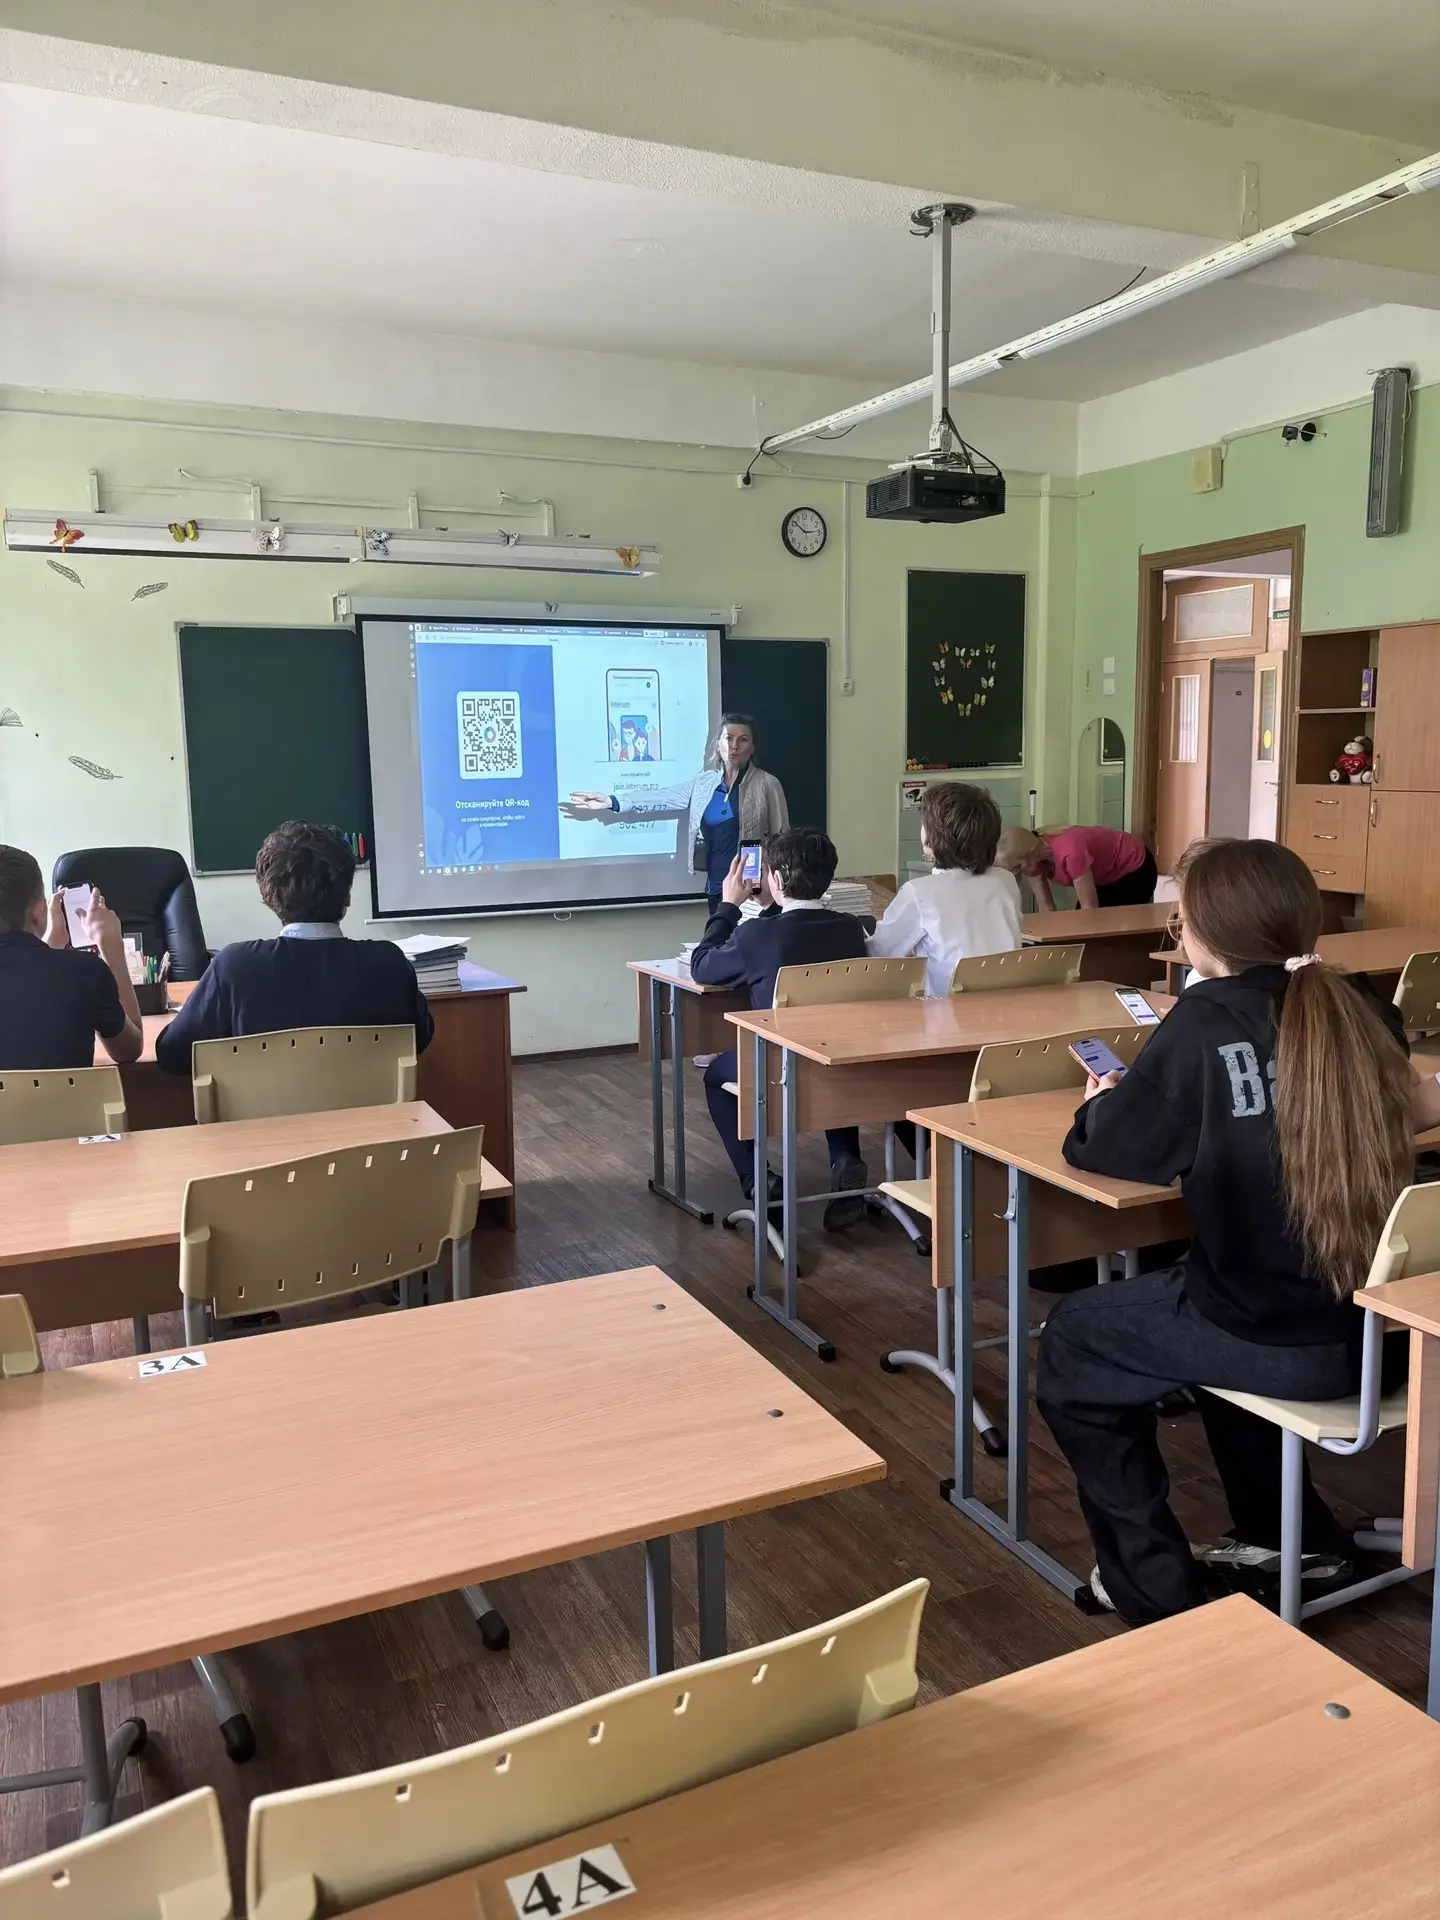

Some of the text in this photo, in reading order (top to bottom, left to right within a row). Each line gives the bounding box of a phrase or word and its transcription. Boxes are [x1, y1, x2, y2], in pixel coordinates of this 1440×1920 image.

[801, 513, 808, 521] 12
[455, 798, 530, 810] Отсканируйте QR-код
